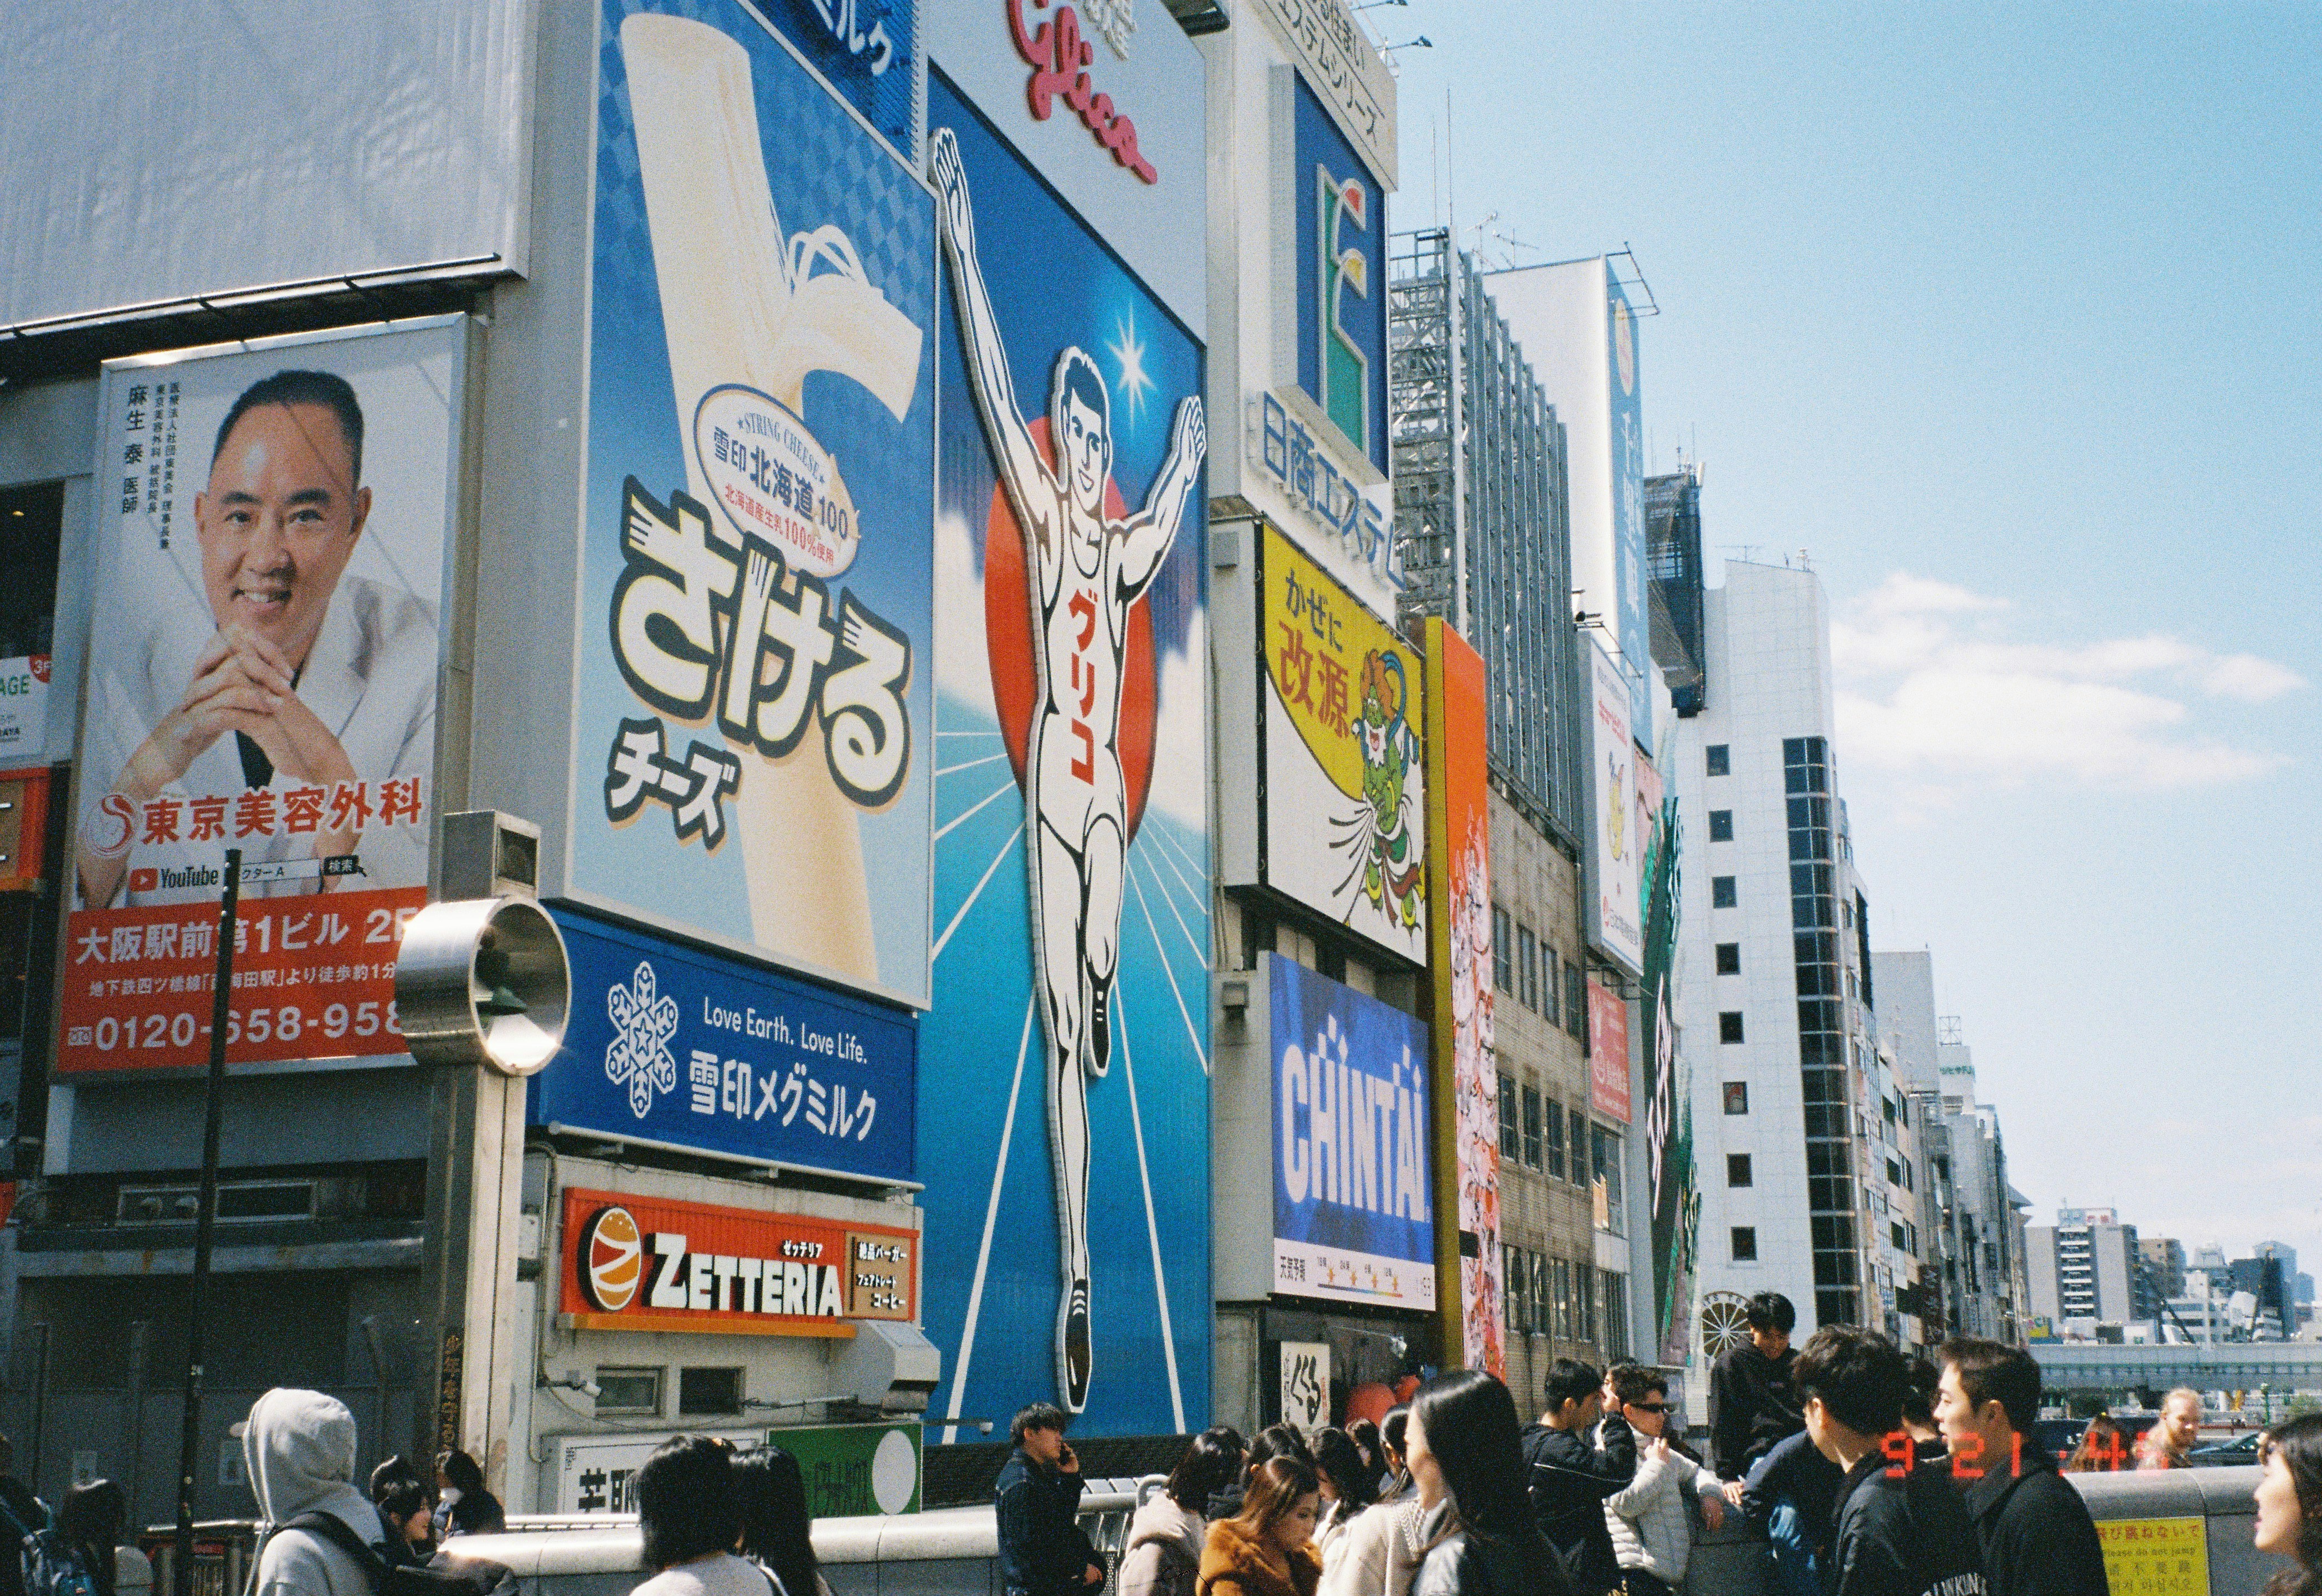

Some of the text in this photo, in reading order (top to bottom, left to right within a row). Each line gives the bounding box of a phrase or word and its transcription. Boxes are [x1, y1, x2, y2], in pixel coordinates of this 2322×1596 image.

[1007, 0, 1158, 184] Glico
[127, 383, 148, 431] 麻生
[744, 412, 820, 480] STRING CHEESE
[121, 477, 138, 514] 医師
[1263, 390, 1407, 593] 日商エステム
[610, 474, 910, 807] さける
[1285, 567, 1344, 653] かぜに
[1068, 588, 1098, 787] グリコ
[1278, 622, 1350, 740] 改源
[141, 777, 423, 845] 東京美容外科
[604, 717, 741, 849] チーズ
[160, 865, 219, 888] YouTube
[90, 962, 398, 997] 地下鉄四ツ橋線「梅田駅」より徒歩約1分
[705, 995, 869, 1064] Love Earth. Love Life.
[689, 1050, 877, 1141] 雪印メグミルク
[1282, 1025, 1425, 1223] CHINTAI
[649, 1232, 844, 1317] ZETTERIA
[783, 1239, 823, 1259] ゼッテリア
[858, 1241, 907, 1263] 絶品バーガー
[1280, 1255, 1306, 1282] 天気予報
[871, 1292, 906, 1310] コーヒー
